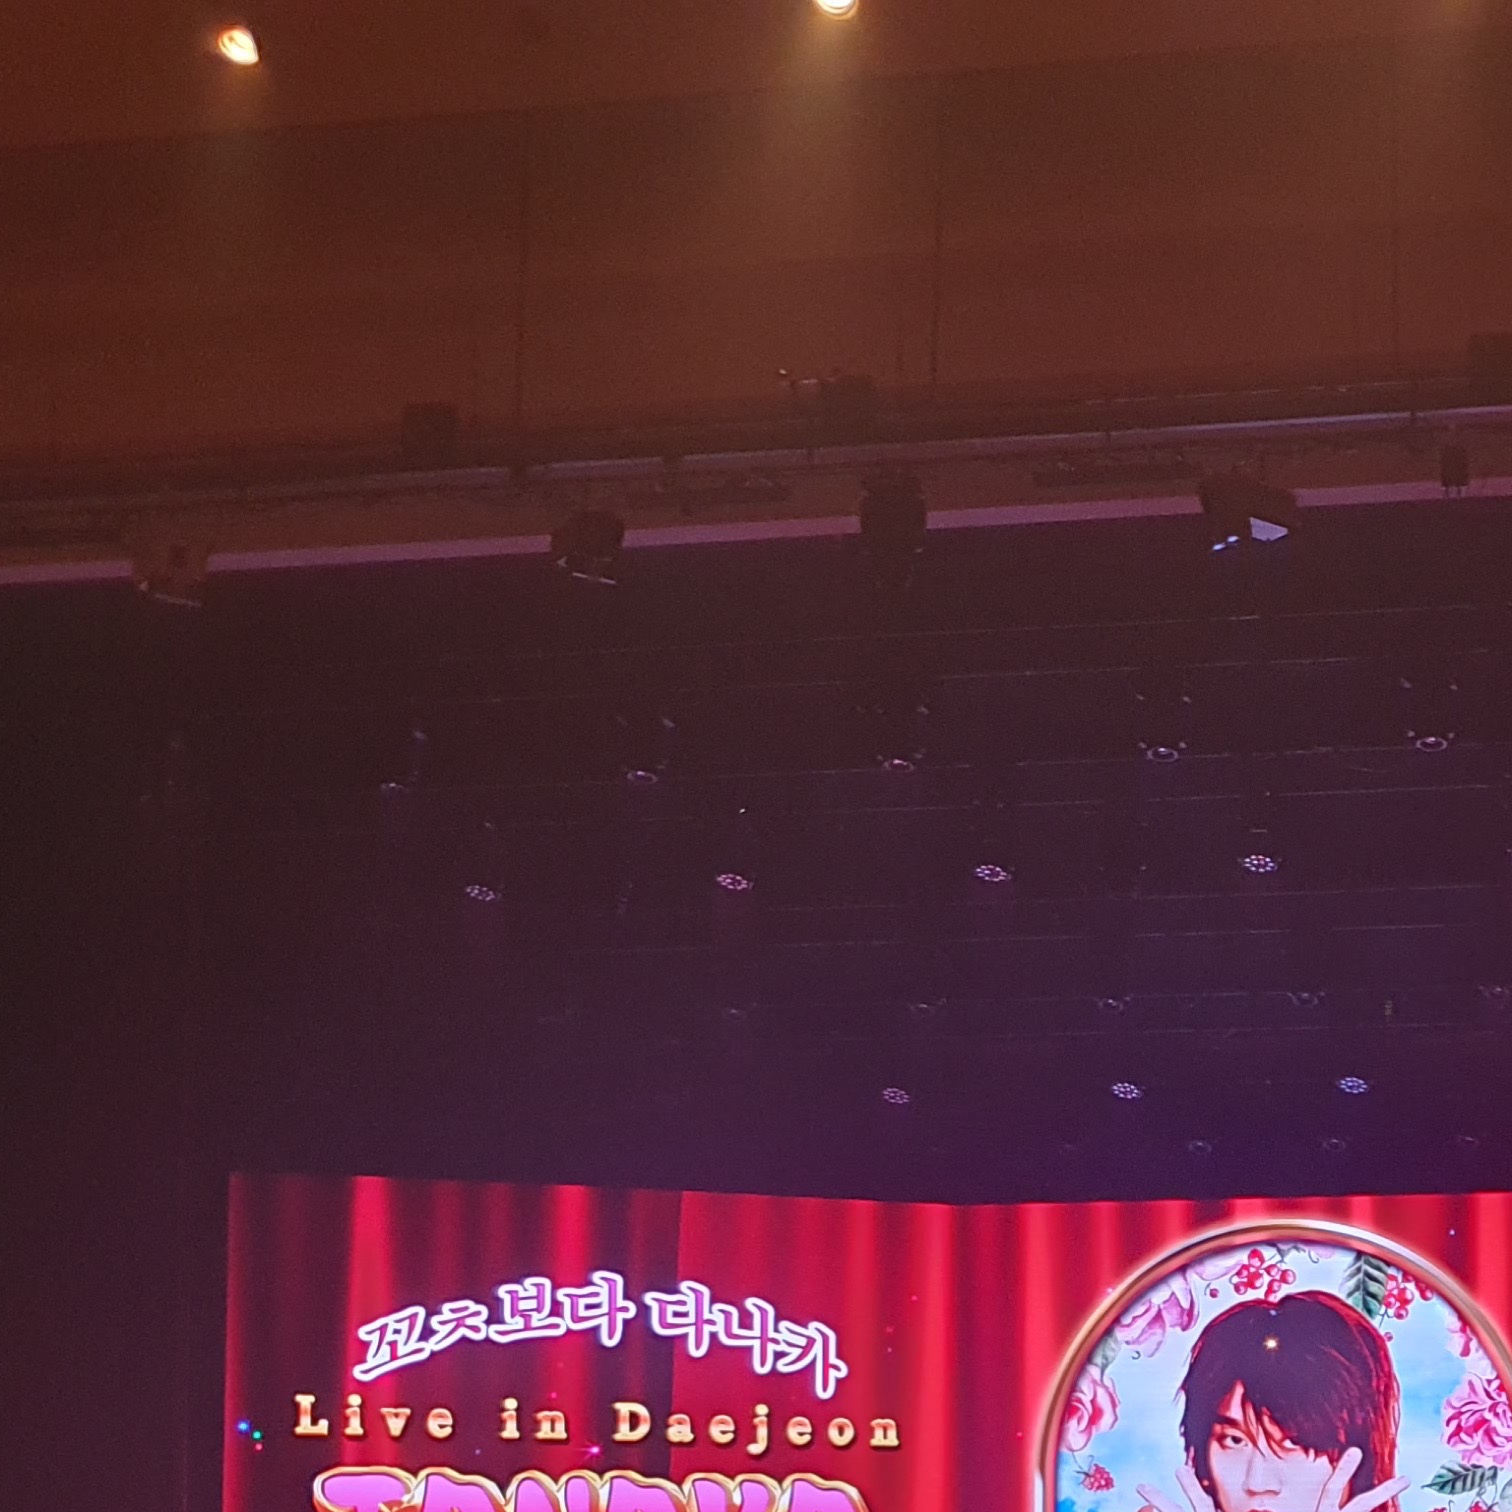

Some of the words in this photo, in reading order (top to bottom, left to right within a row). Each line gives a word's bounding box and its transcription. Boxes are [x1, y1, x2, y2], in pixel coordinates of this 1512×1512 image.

[644, 1280, 848, 1400] 다나카
[293, 1394, 454, 1437] Live
[498, 1398, 569, 1440] in
[612, 1401, 900, 1455] Daejeon
